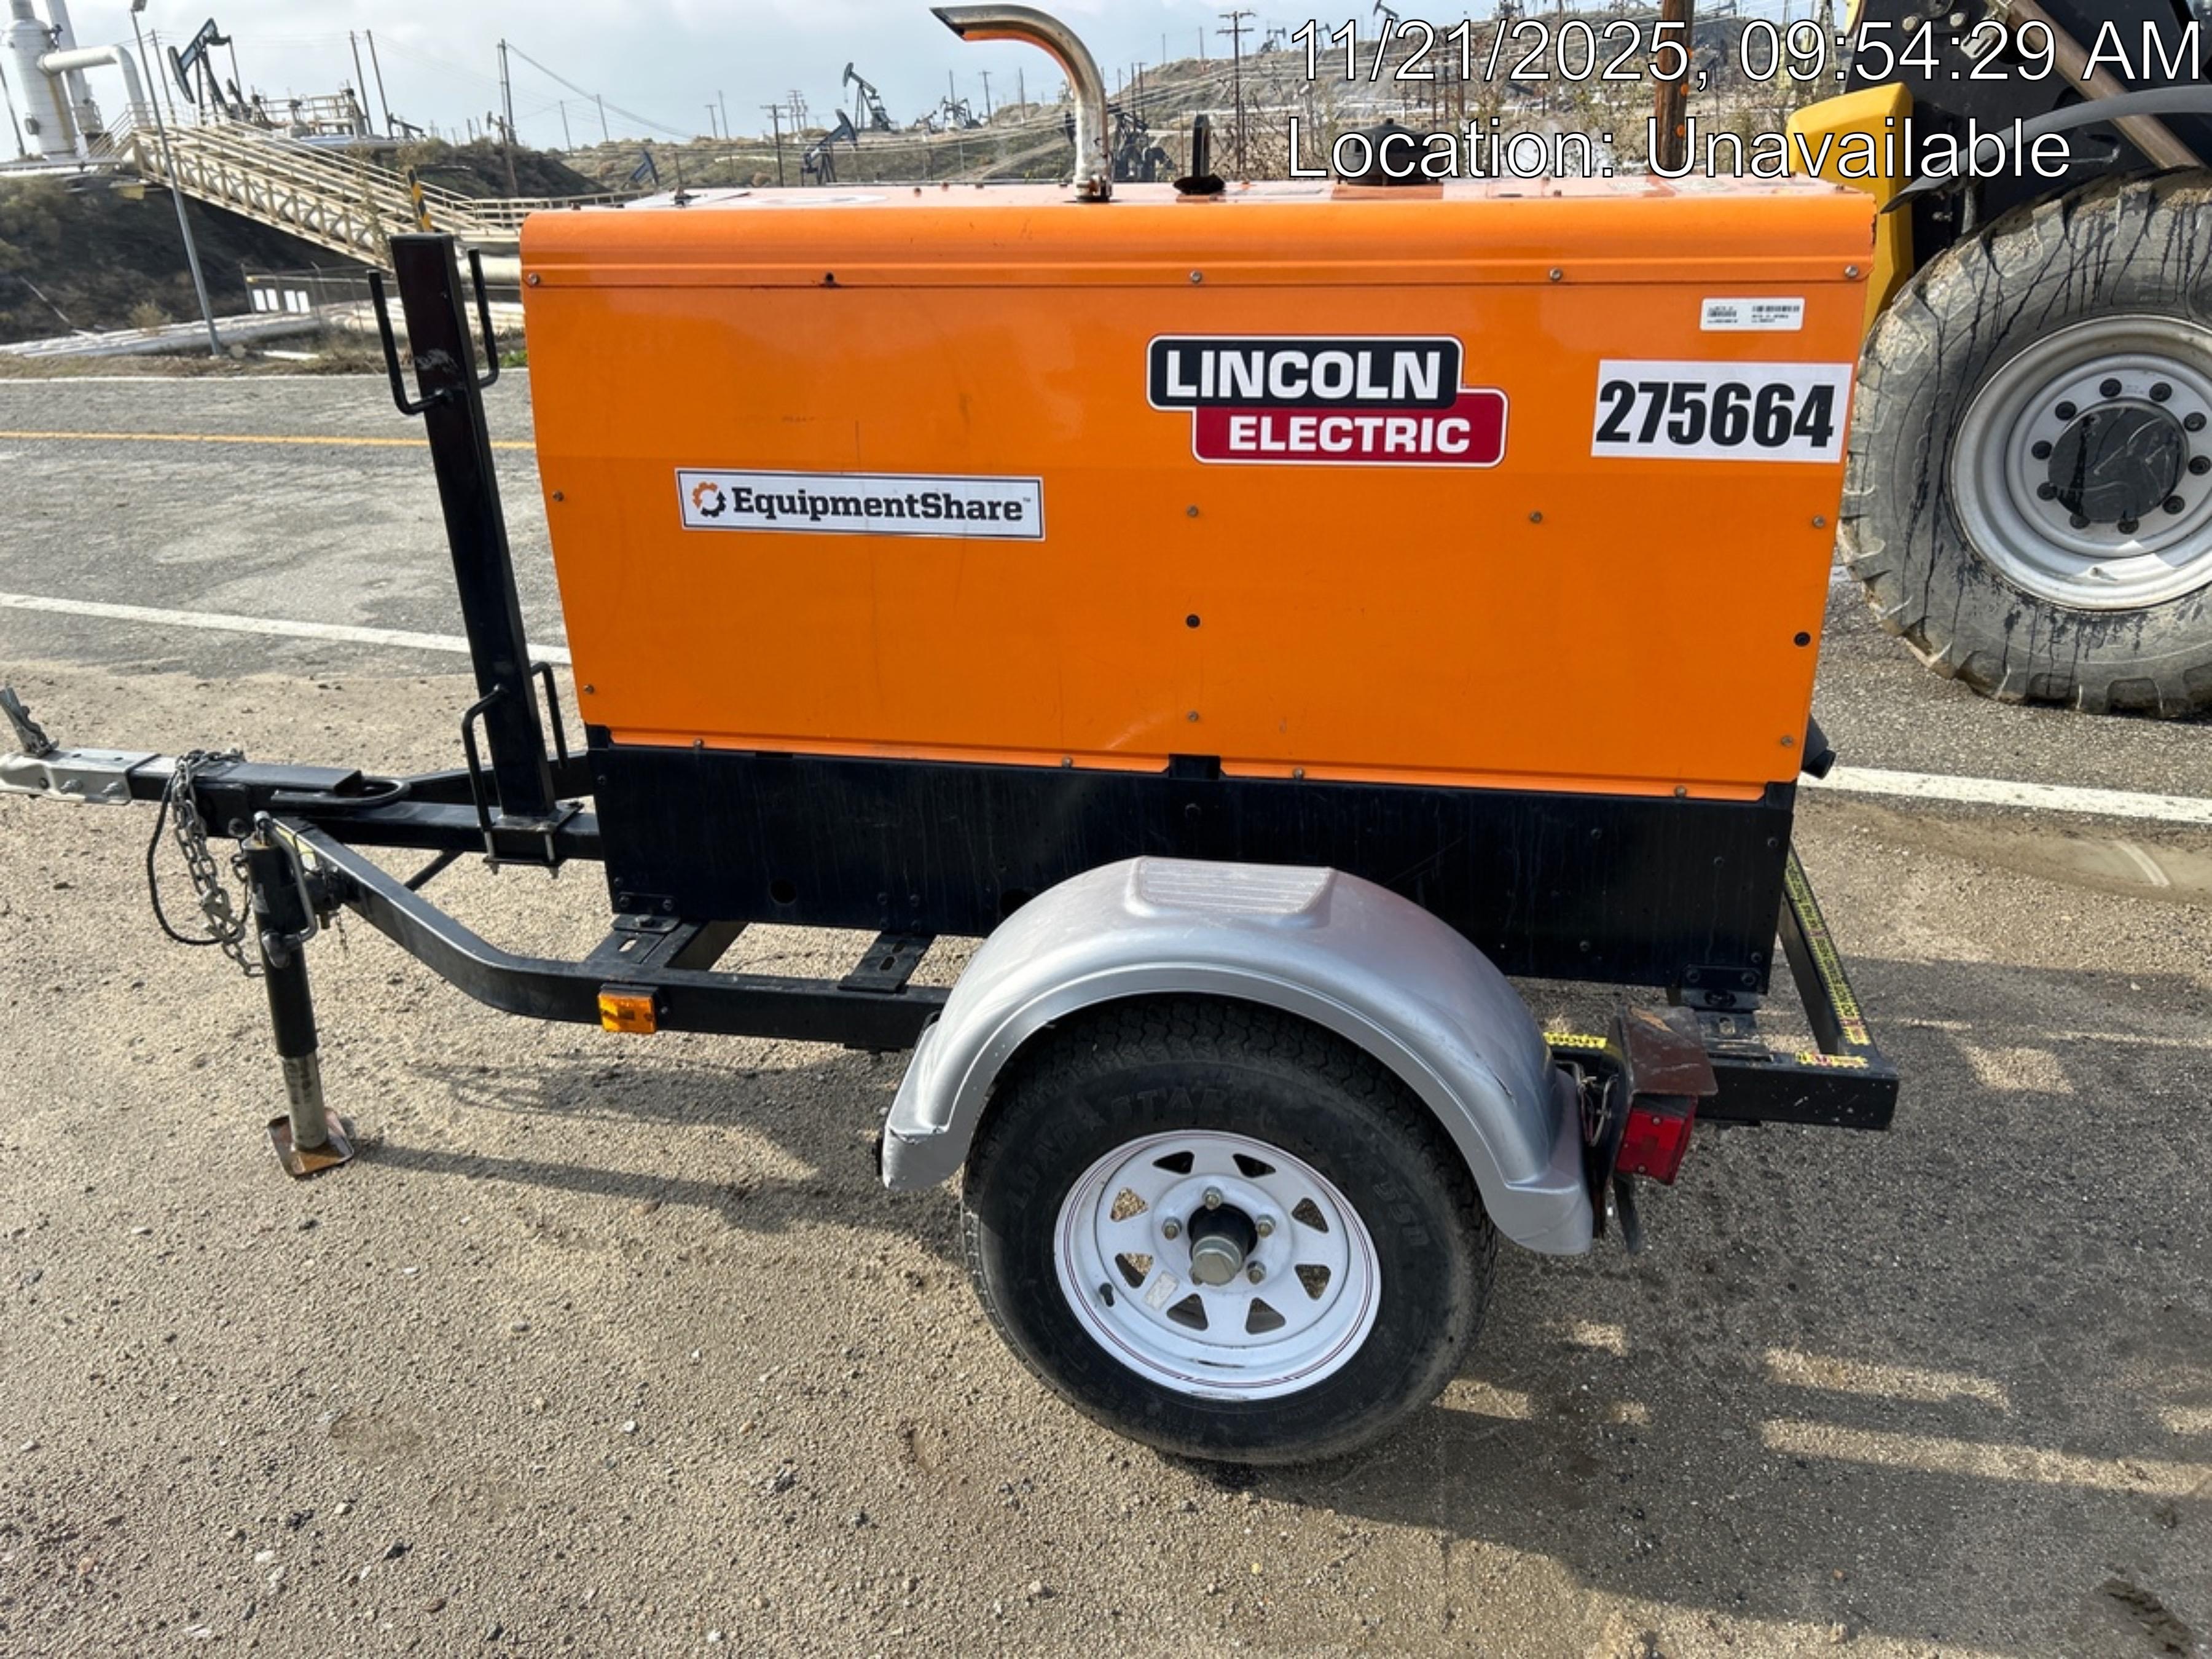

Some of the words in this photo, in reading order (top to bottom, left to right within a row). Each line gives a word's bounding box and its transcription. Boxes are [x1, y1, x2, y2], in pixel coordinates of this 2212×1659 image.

[1166, 350, 1440, 400] LINCOLN
[1228, 415, 1471, 454] ELECTRIC
[1596, 380, 1835, 447] 275664
